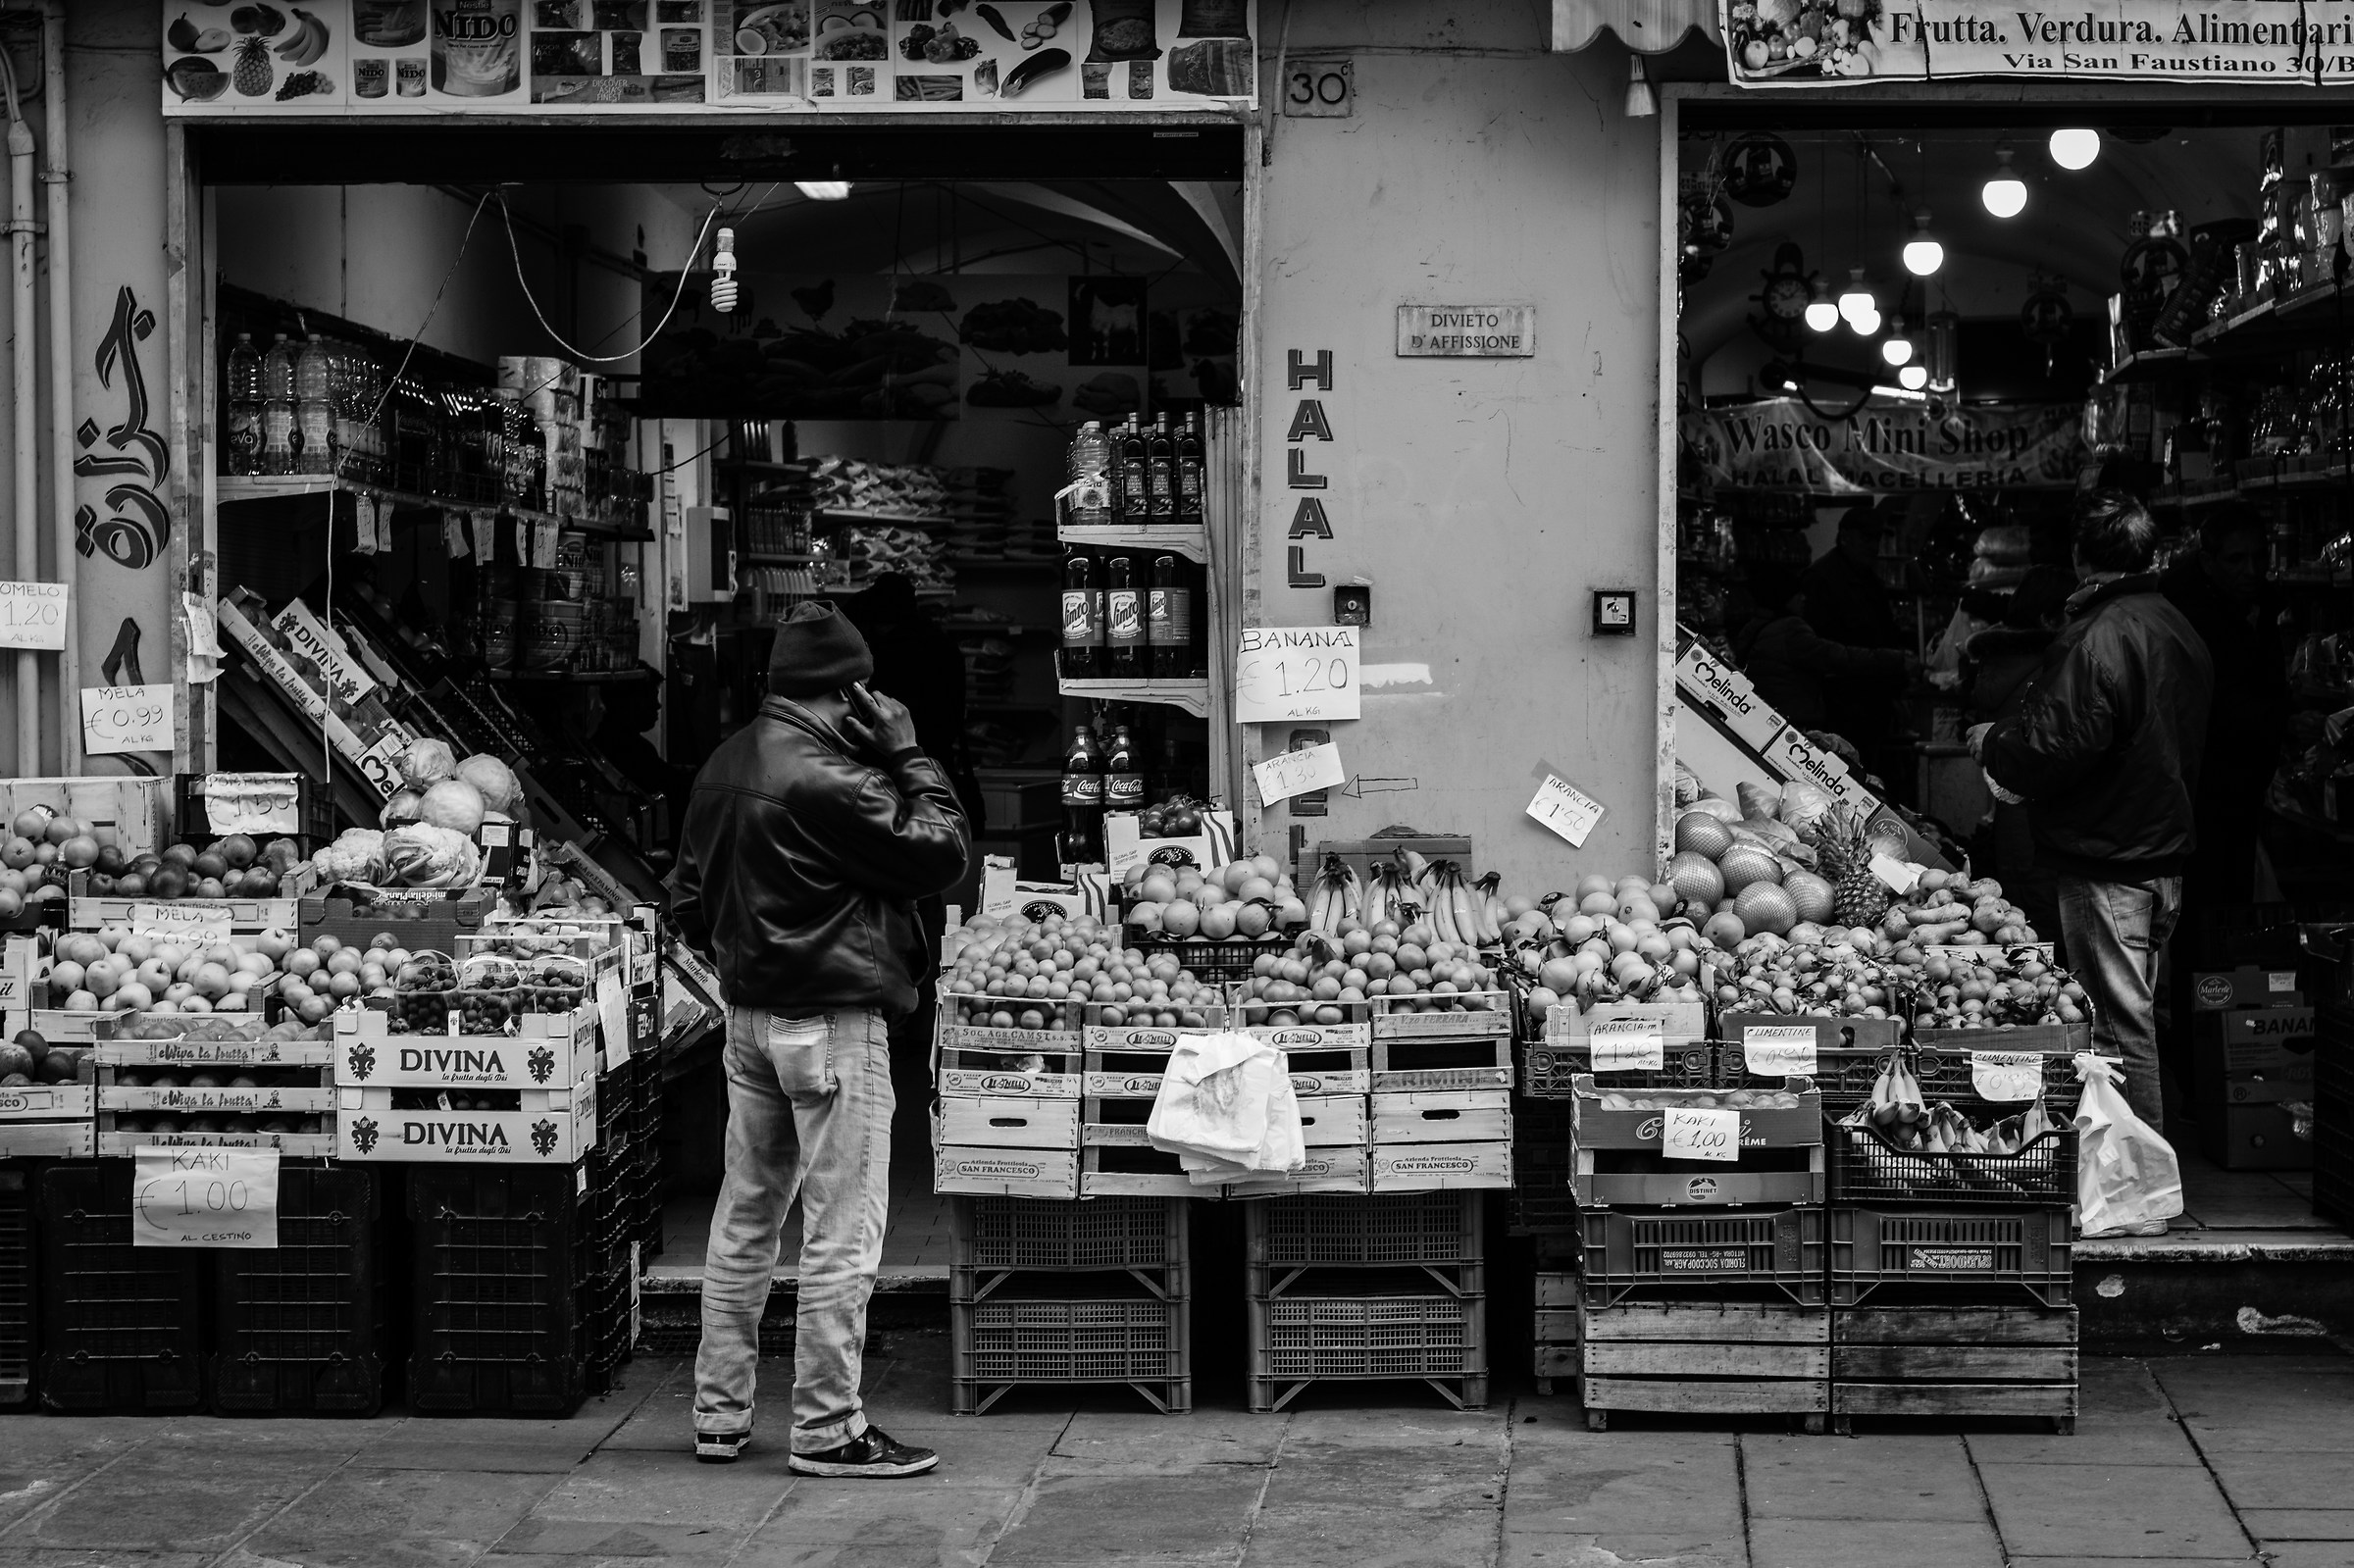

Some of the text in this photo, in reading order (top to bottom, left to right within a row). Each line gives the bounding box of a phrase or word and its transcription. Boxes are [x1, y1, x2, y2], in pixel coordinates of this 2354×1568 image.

[434, 8, 518, 40] NIDO
[1890, 12, 2007, 45] Frutta.
[2019, 12, 2163, 45] Verdura.
[358, 68, 384, 76] NIDO
[397, 68, 426, 78] NIDO
[2002, 53, 2053, 70] Via
[2064, 53, 2119, 71] San
[2130, 53, 2277, 73] Faustiano
[1431, 314, 1499, 329] DIVIETO
[1412, 334, 1520, 350] D'AFFISSIONE
[1724, 417, 2028, 461] Wasco Mini Shop
[1287, 348, 1334, 588] HALAL
[1731, 469, 2027, 488] HALAL MACELLERIA
[4, 601, 59, 627] 1.20
[1108, 601, 1140, 629] Vimto
[1240, 631, 1354, 653] BANANA
[294, 626, 344, 683] DIVINA
[1275, 657, 1348, 696] 1.20
[98, 687, 145, 700] MELA
[1695, 662, 1752, 715] Melinda
[113, 705, 164, 727] 0.99
[1265, 751, 1315, 772] ARANCIA
[1789, 743, 1846, 796] Melinda
[1277, 765, 1316, 790] 1.30
[1549, 778, 1599, 813] ARANCIA
[156, 907, 204, 923] MELA
[1423, 1014, 1469, 1024] FERRARA
[1747, 1028, 1813, 1037] CLIMENTINE
[400, 1049, 505, 1073] DIVINA
[1974, 1053, 2040, 1063] CLIMENTINE
[1673, 1113, 1716, 1127] KAKI
[404, 1123, 508, 1145] DIVINA
[172, 1148, 230, 1172] KAKI
[454, 1146, 477, 1155] frutta
[982, 1166, 1035, 1175] FRANCESCO
[175, 1179, 248, 1217] 1.00
[202, 1231, 252, 1241] CESTINO
[1720, 1258, 1746, 1269] FLORIDA
